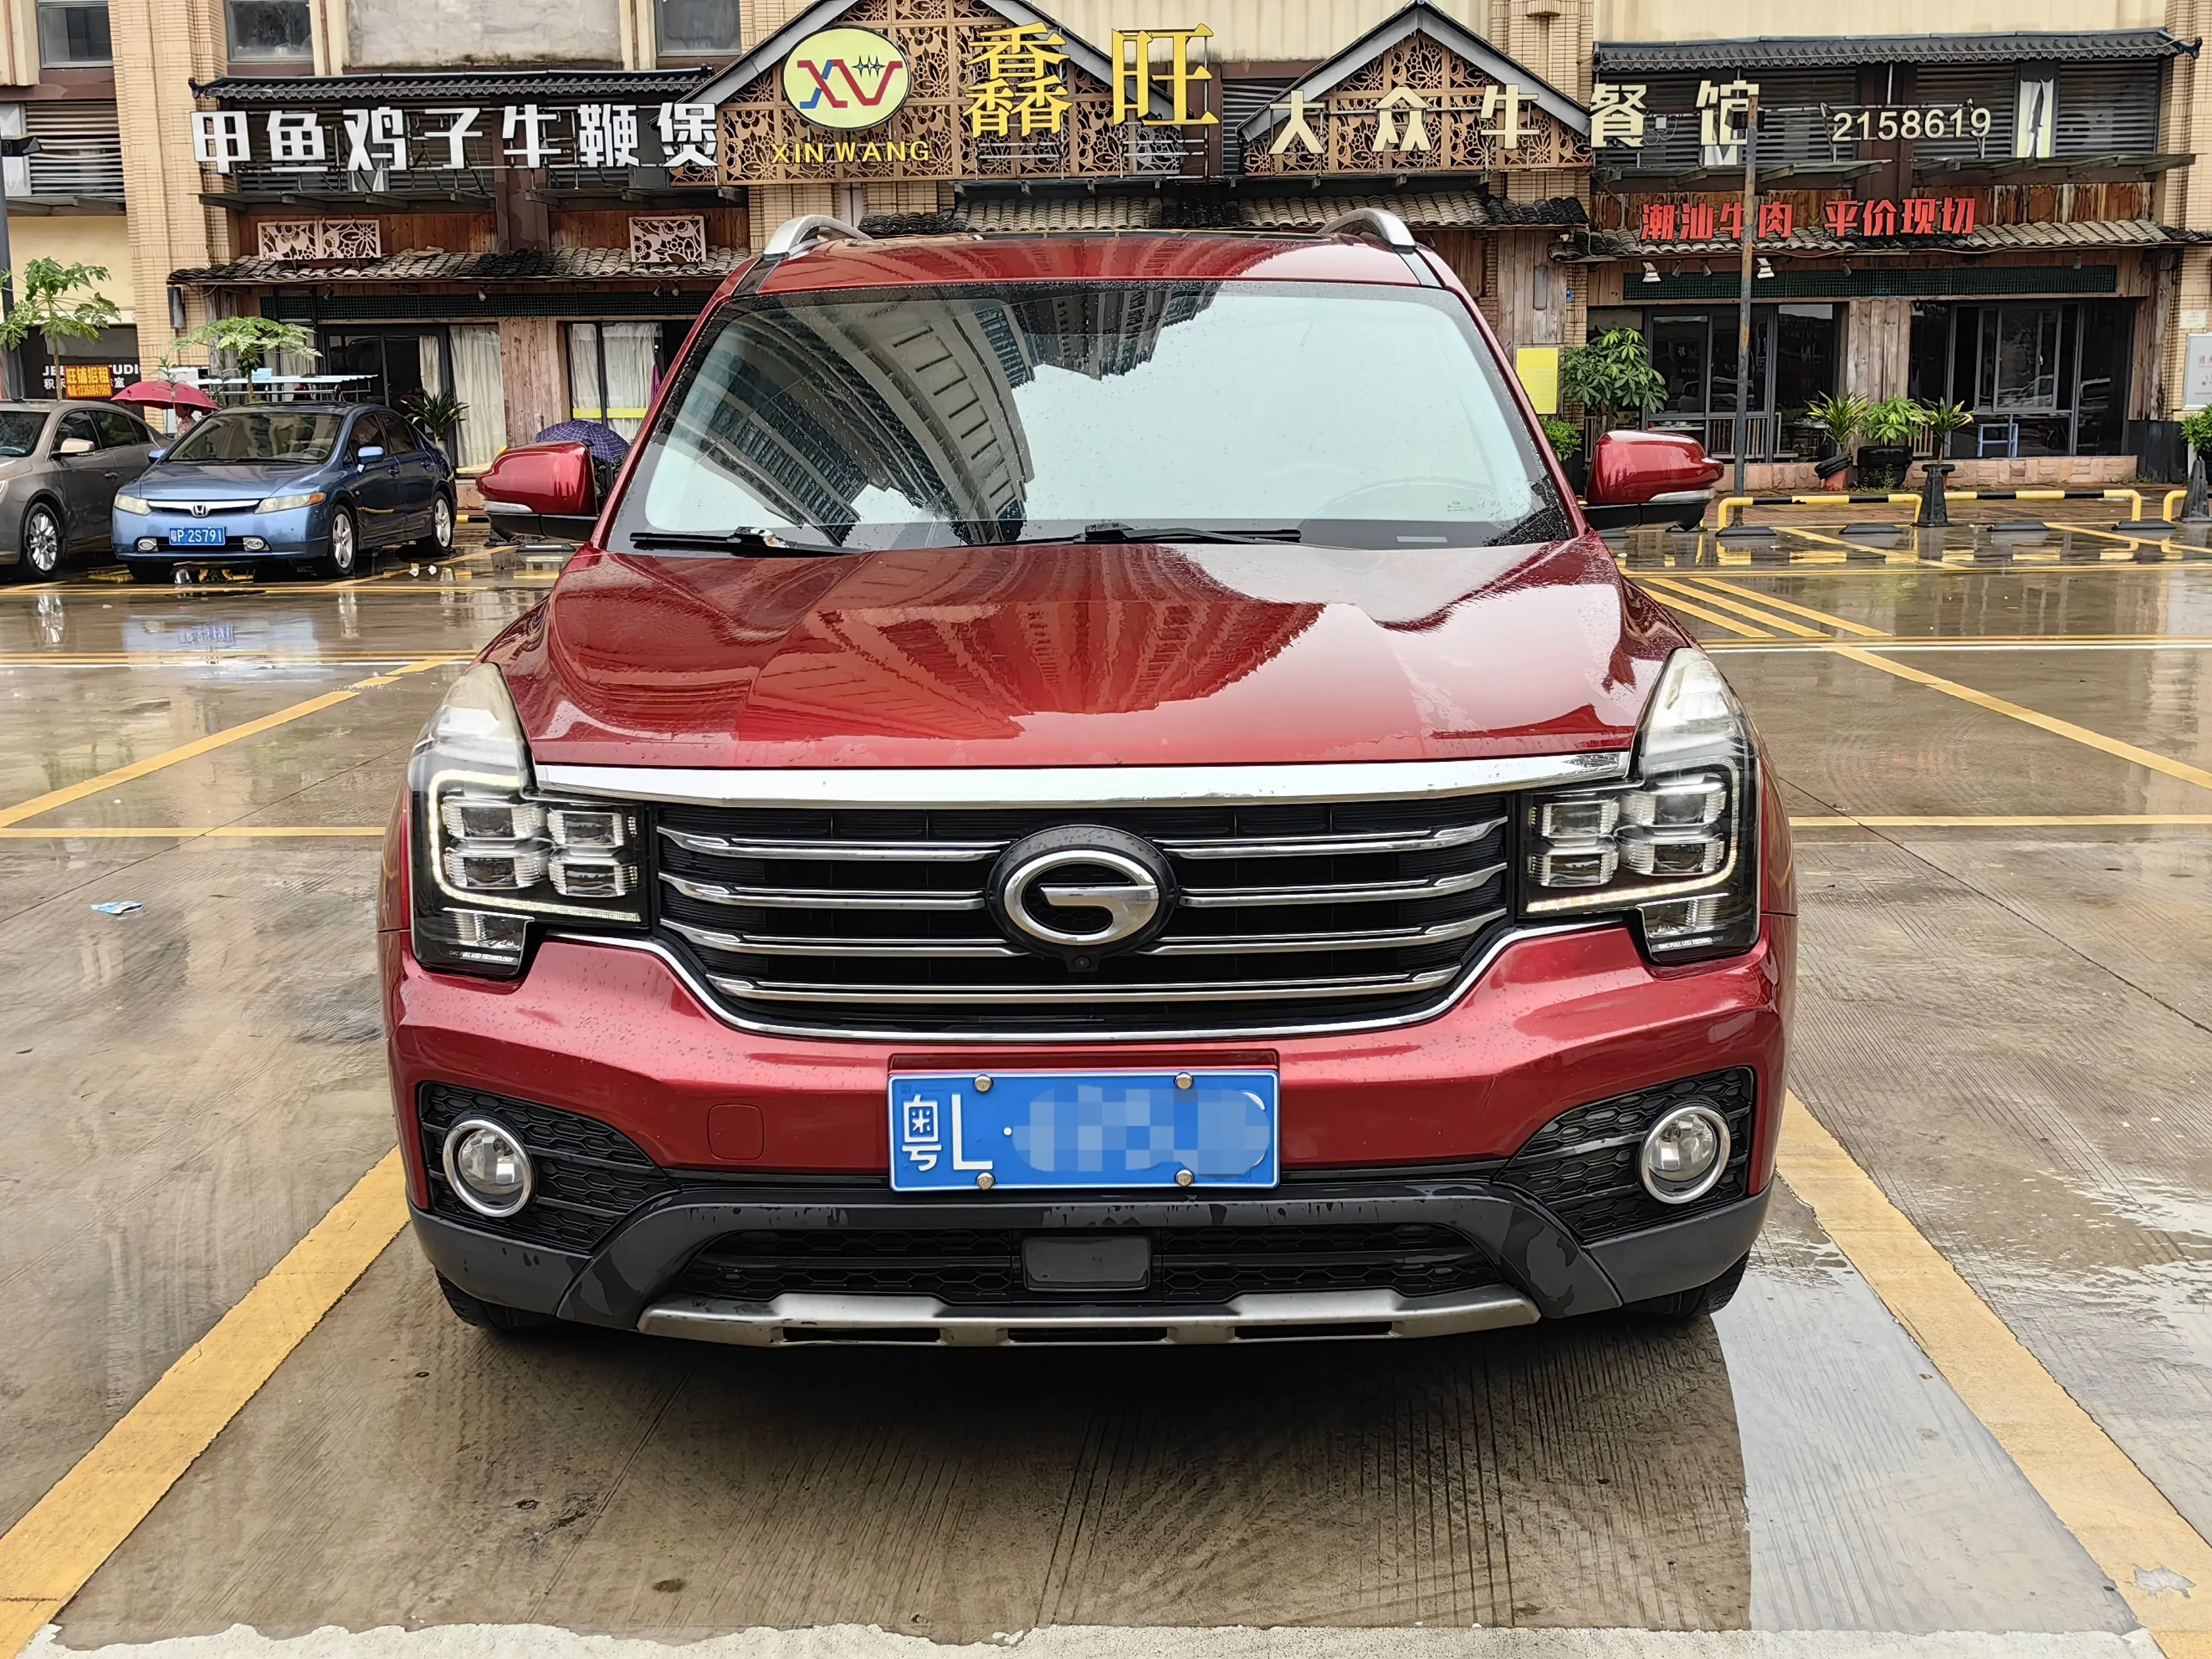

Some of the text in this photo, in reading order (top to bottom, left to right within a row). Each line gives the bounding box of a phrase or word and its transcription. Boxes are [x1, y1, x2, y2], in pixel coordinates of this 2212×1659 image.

[191, 103, 718, 174] 甲鱼鸡子牛鞭煲
[1832, 108, 1991, 142] 2158619
[771, 141, 930, 164] XIN WANG
[1641, 197, 1976, 240] 潮汕牛肉 平价现切
